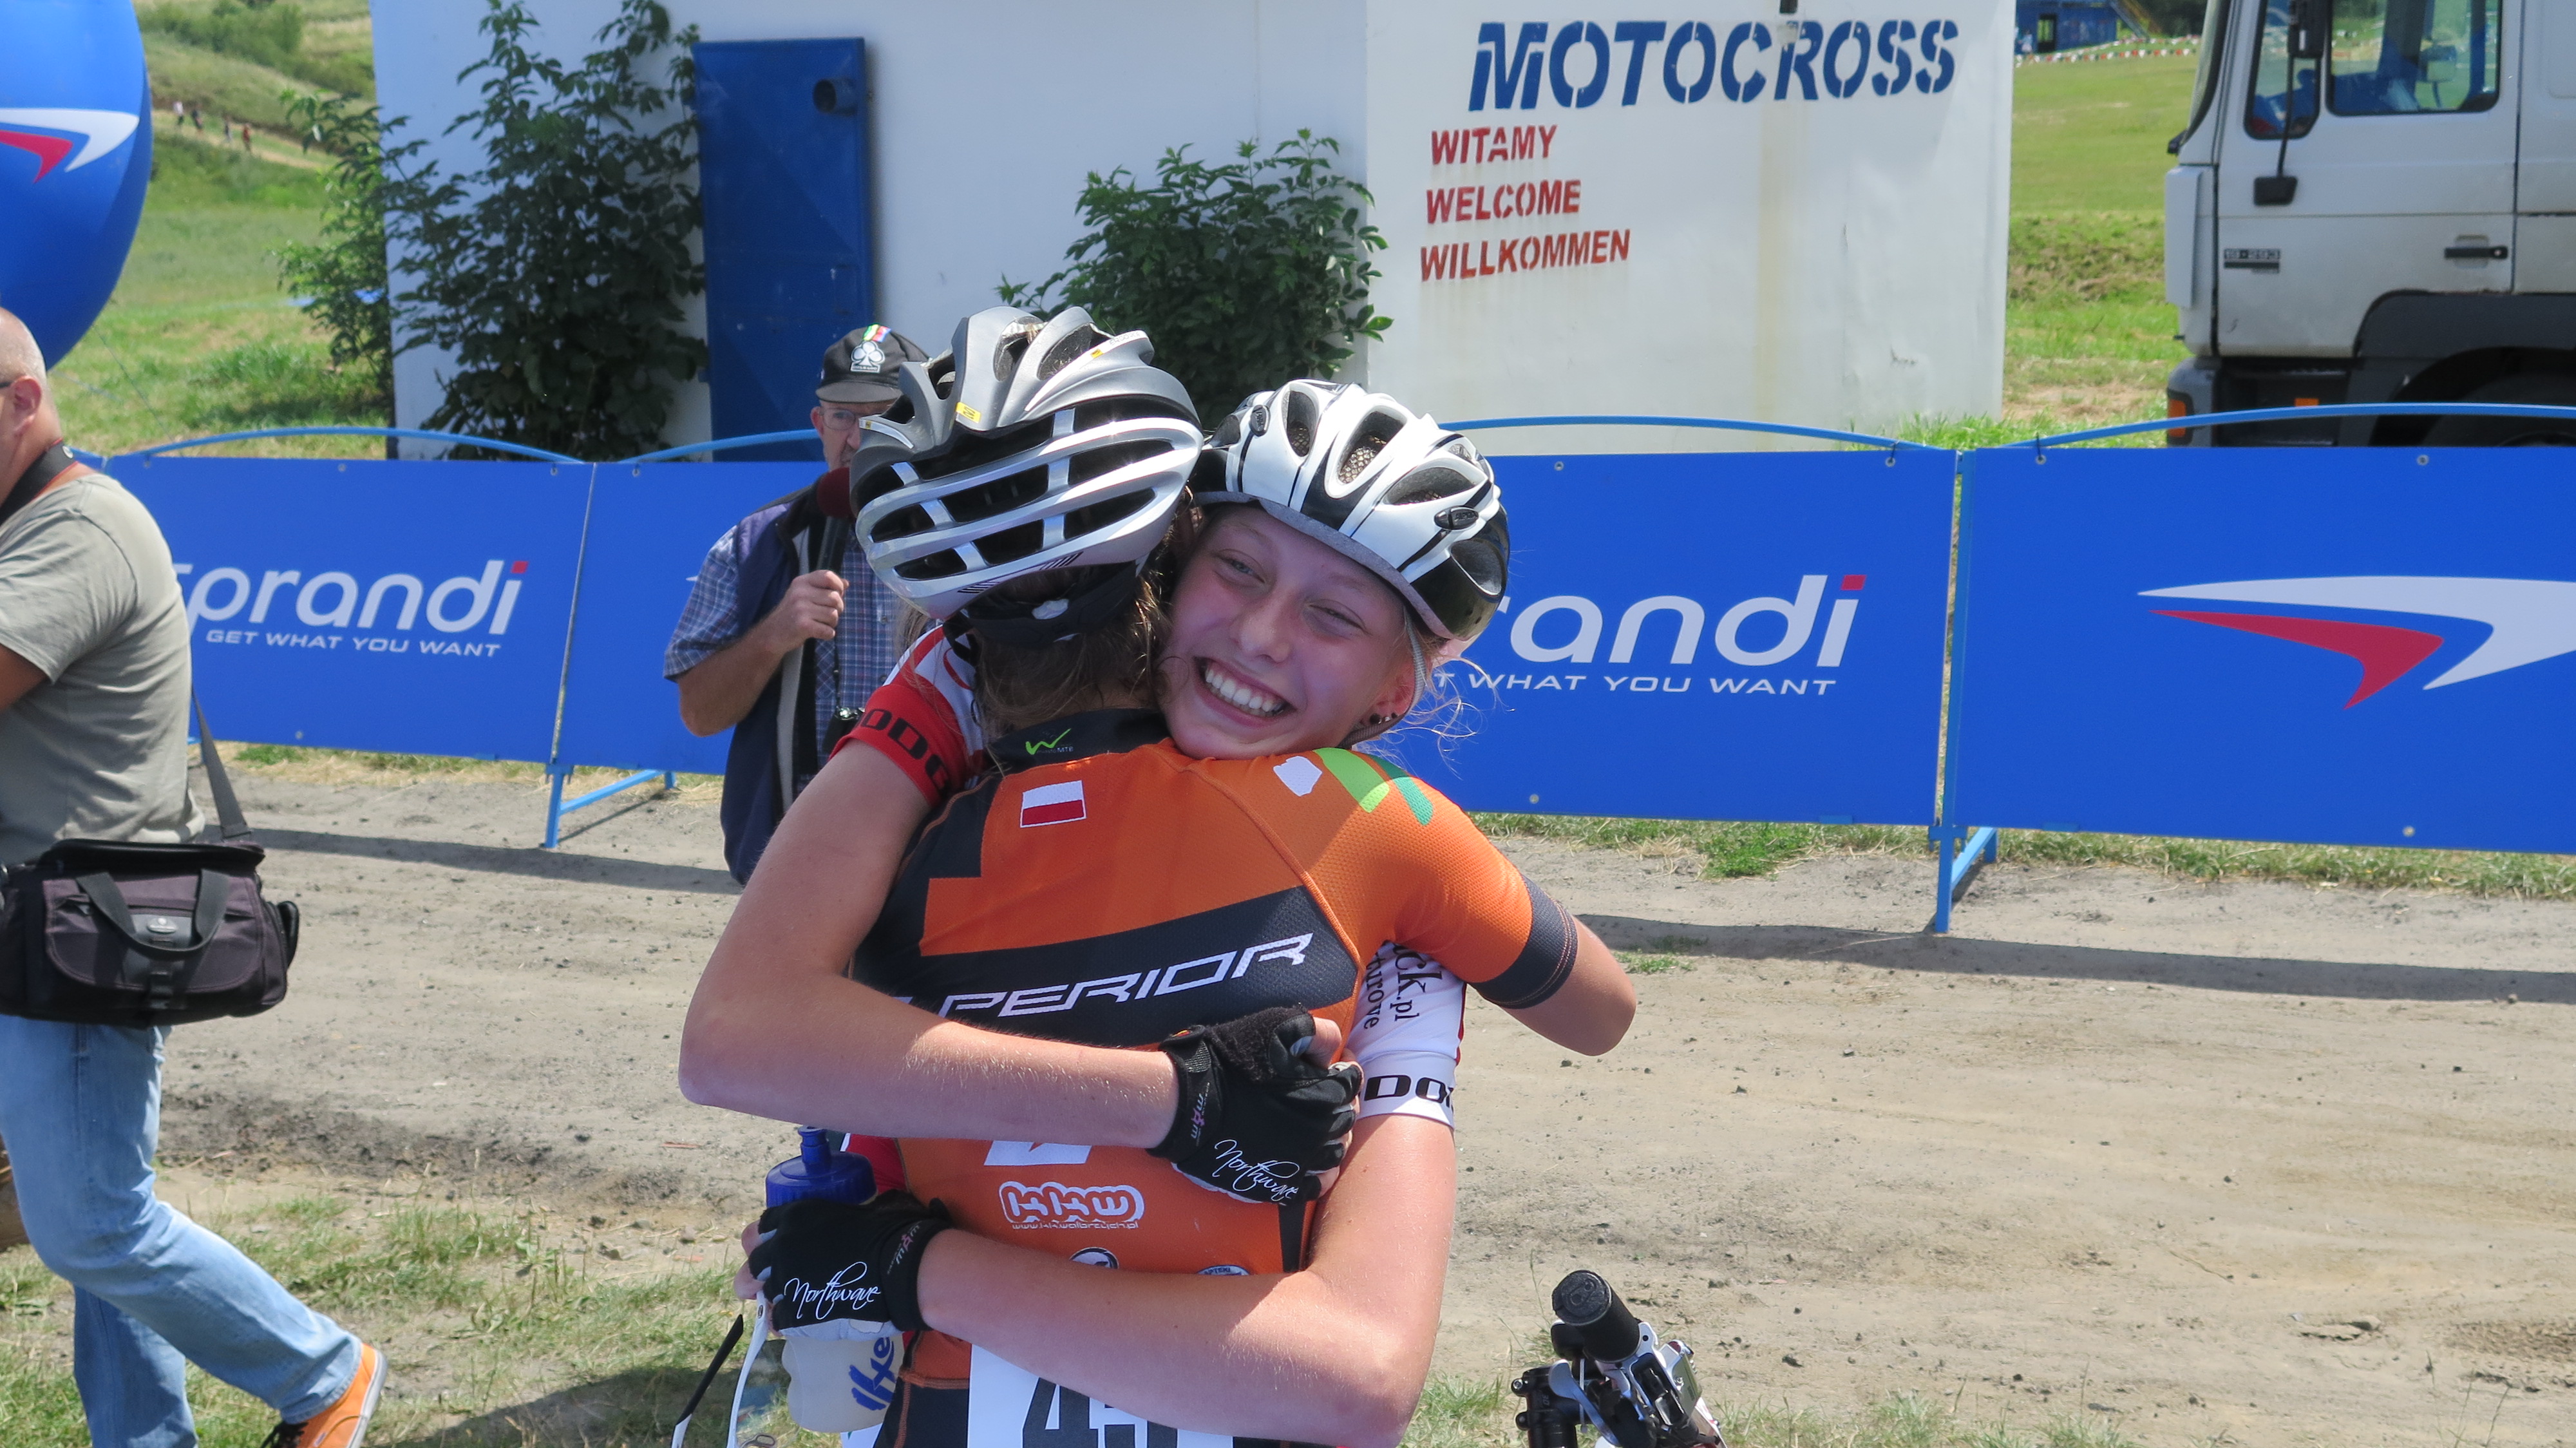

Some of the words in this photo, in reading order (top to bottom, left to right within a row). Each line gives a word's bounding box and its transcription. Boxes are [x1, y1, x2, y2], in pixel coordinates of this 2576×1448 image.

[1468, 19, 1959, 111] MOTOCROSS
[1430, 124, 1558, 166] WITAMY
[1425, 180, 1582, 225] WELCOME
[1420, 229, 1631, 282] WILLKOMMEN
[172, 560, 529, 640] prandi
[1497, 574, 1867, 667] andi
[205, 629, 259, 645] GET
[265, 633, 343, 651] WHAT
[352, 637, 410, 654] YOU
[419, 640, 502, 658] WANT
[1468, 674, 1587, 691] WHAT
[1604, 676, 1692, 694] YOU
[1709, 678, 1837, 696] WANT
[893, 932, 1314, 1018] PERIOR
[784, 1261, 882, 1320] Northwave
